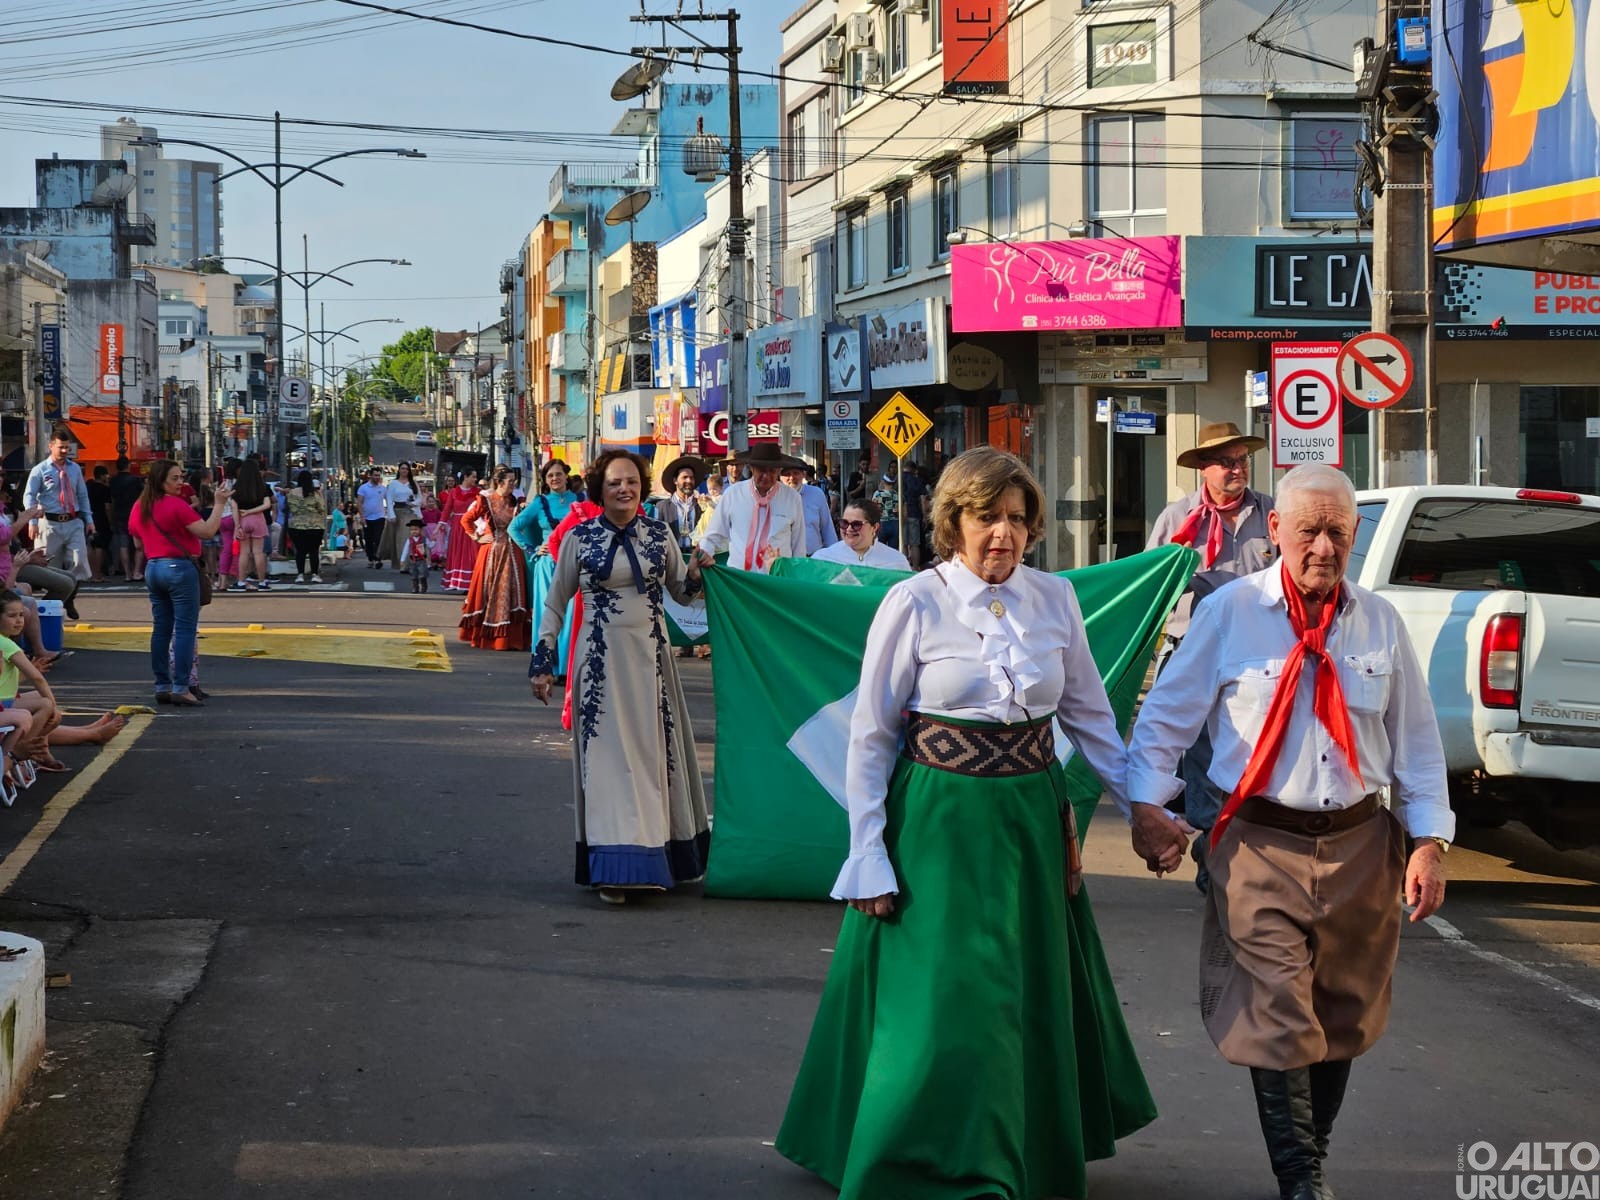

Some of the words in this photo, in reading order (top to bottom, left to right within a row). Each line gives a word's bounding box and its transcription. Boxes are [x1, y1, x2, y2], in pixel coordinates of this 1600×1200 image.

[956, 8, 991, 41] LE
[1102, 44, 1148, 64] 1949
[956, 85, 977, 94] SALA
[1023, 247, 1080, 286] Più
[1085, 247, 1146, 285] Bella
[1269, 255, 1308, 306] LE
[1327, 254, 1373, 306] CA
[1024, 294, 1054, 304] Clínica
[1055, 294, 1067, 303] de
[1068, 293, 1102, 303] Estética
[1103, 290, 1146, 303] Avançada
[1534, 295, 1549, 314] E
[1555, 295, 1600, 314] PRO
[1054, 316, 1078, 327] 3744
[1081, 315, 1107, 327] 6386
[1210, 328, 1299, 340] lecamp.com.br
[1457, 329, 1467, 337] 55
[1468, 329, 1488, 337] 3744
[290, 383, 299, 397] E
[1296, 383, 1318, 416] E
[838, 404, 846, 414] E
[1280, 437, 1335, 448] EXCLUSIVO
[1290, 451, 1325, 461] MOTOS
